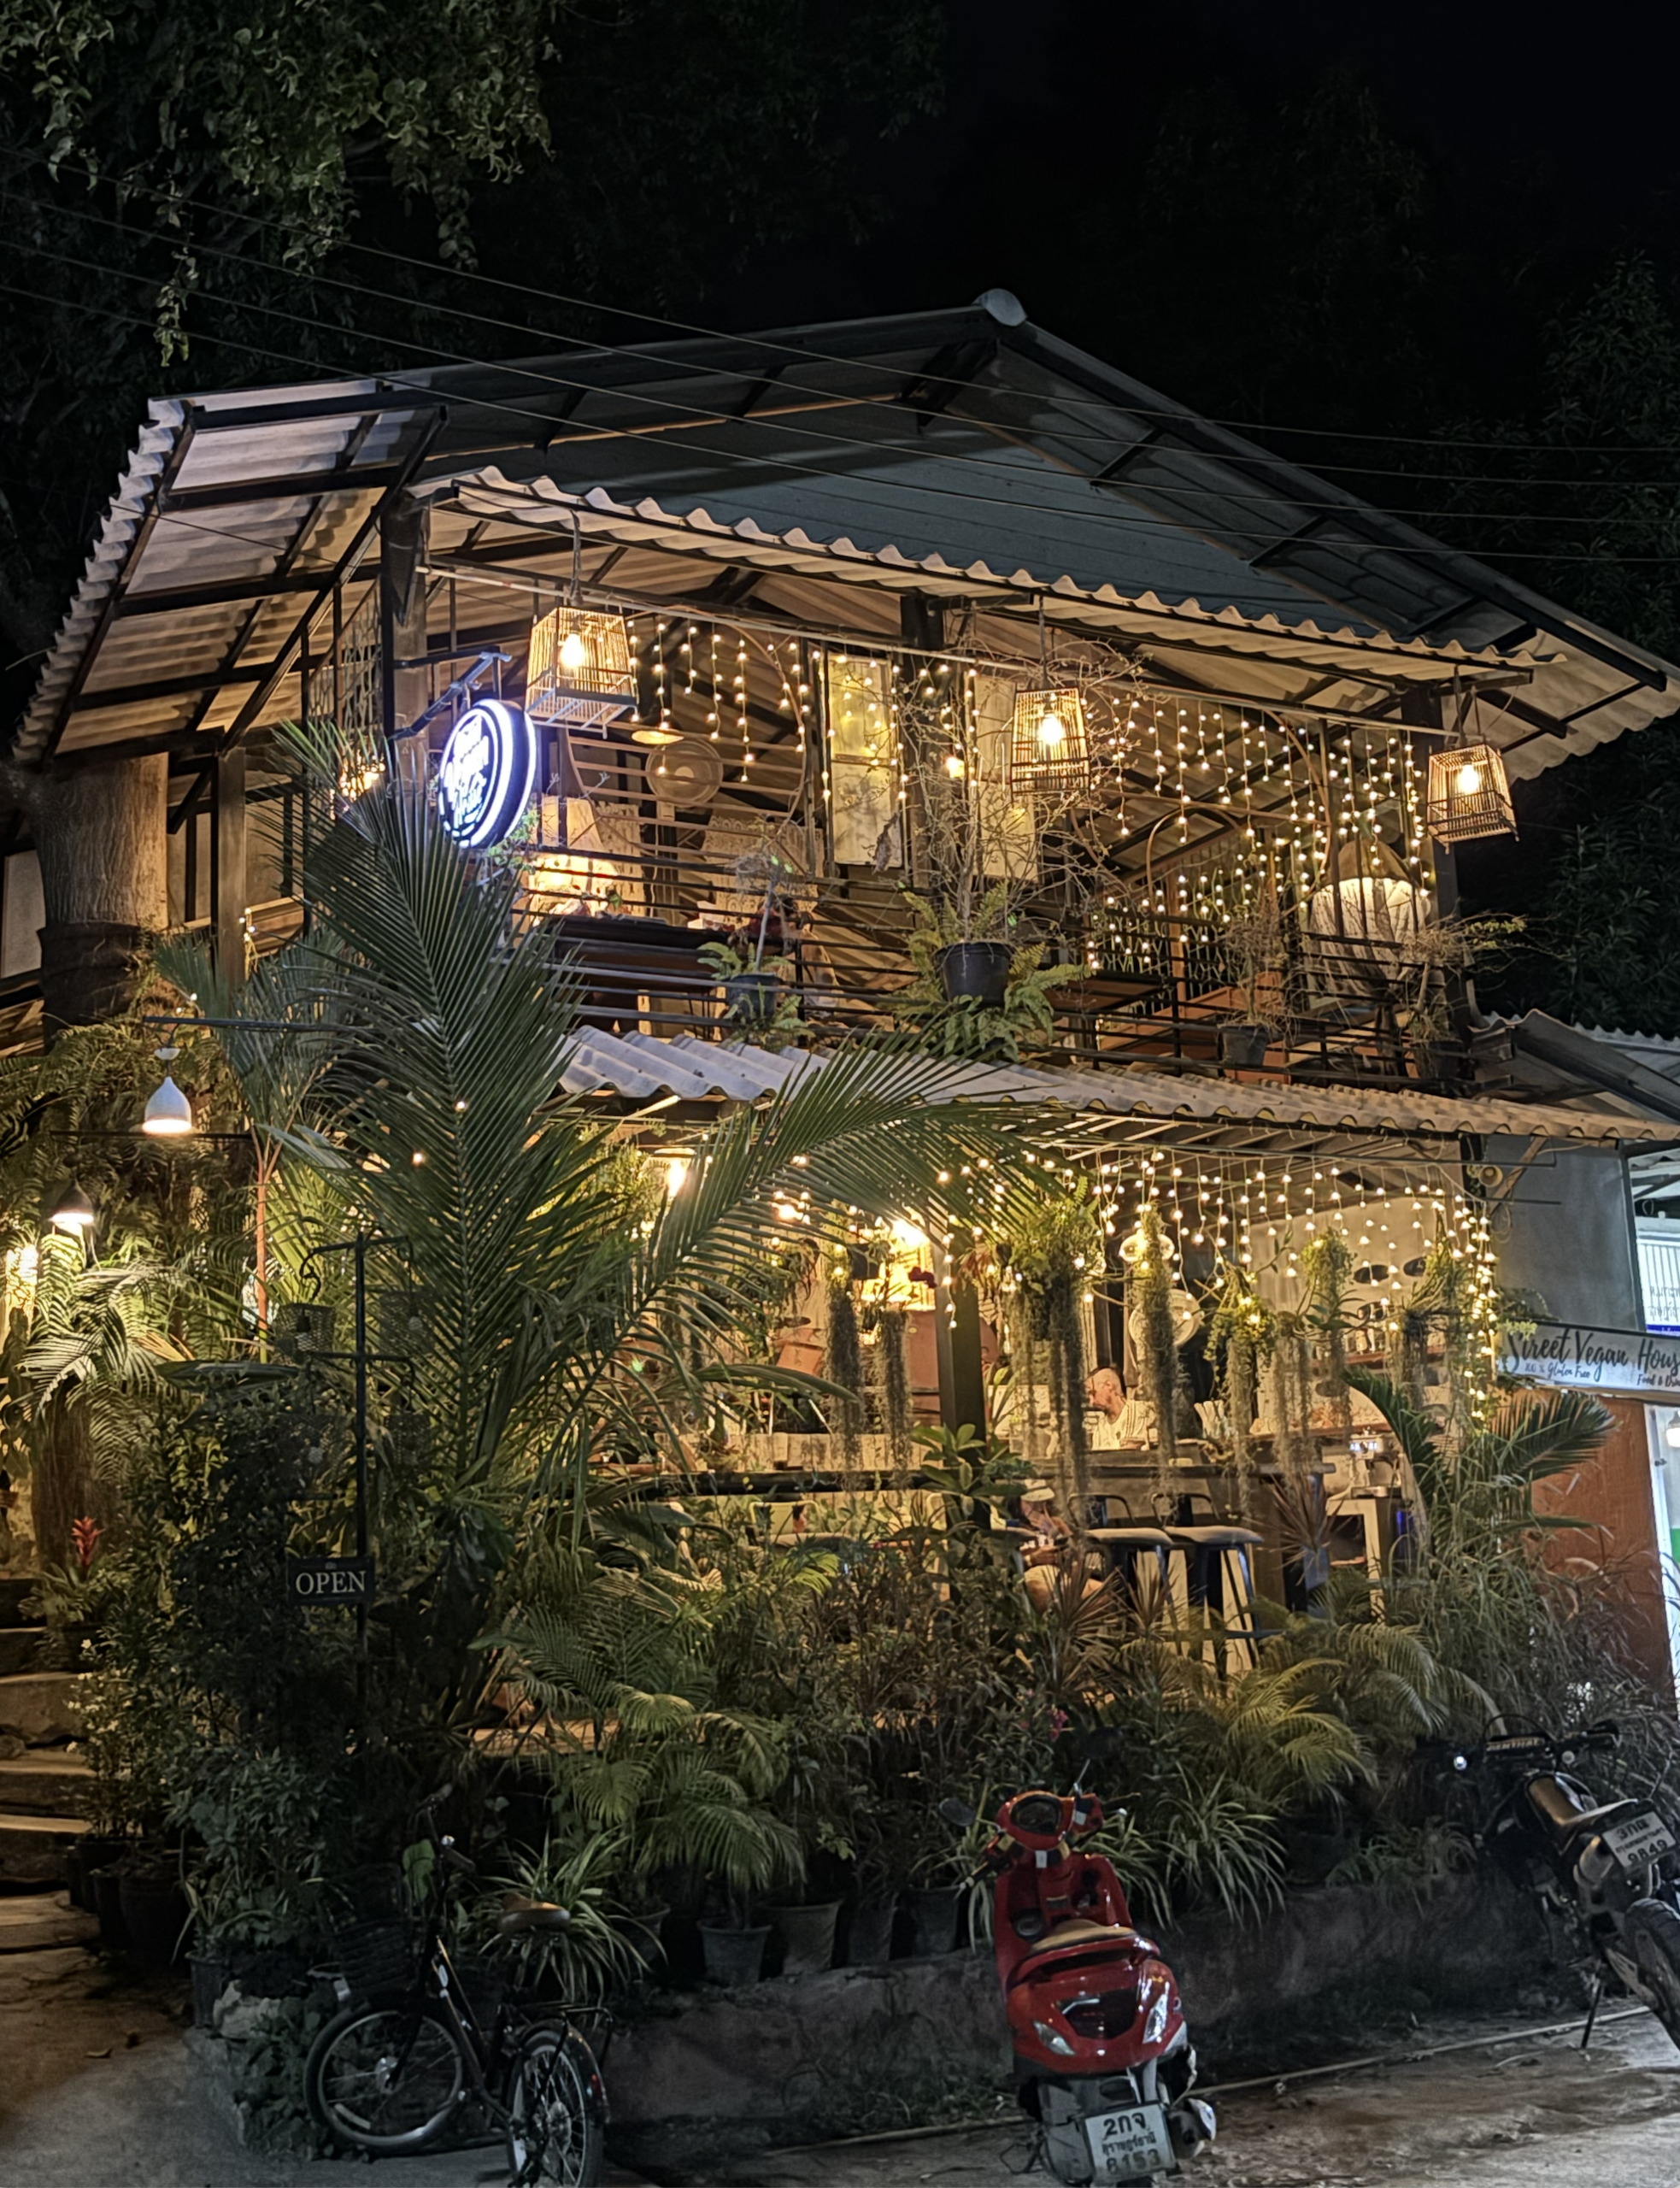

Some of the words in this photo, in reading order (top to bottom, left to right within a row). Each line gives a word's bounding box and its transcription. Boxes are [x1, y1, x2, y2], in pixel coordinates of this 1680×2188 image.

[1575, 1331, 1630, 1382] Vegan
[1638, 1338, 1680, 1376] Hous
[295, 1570, 366, 1595] OPEN
